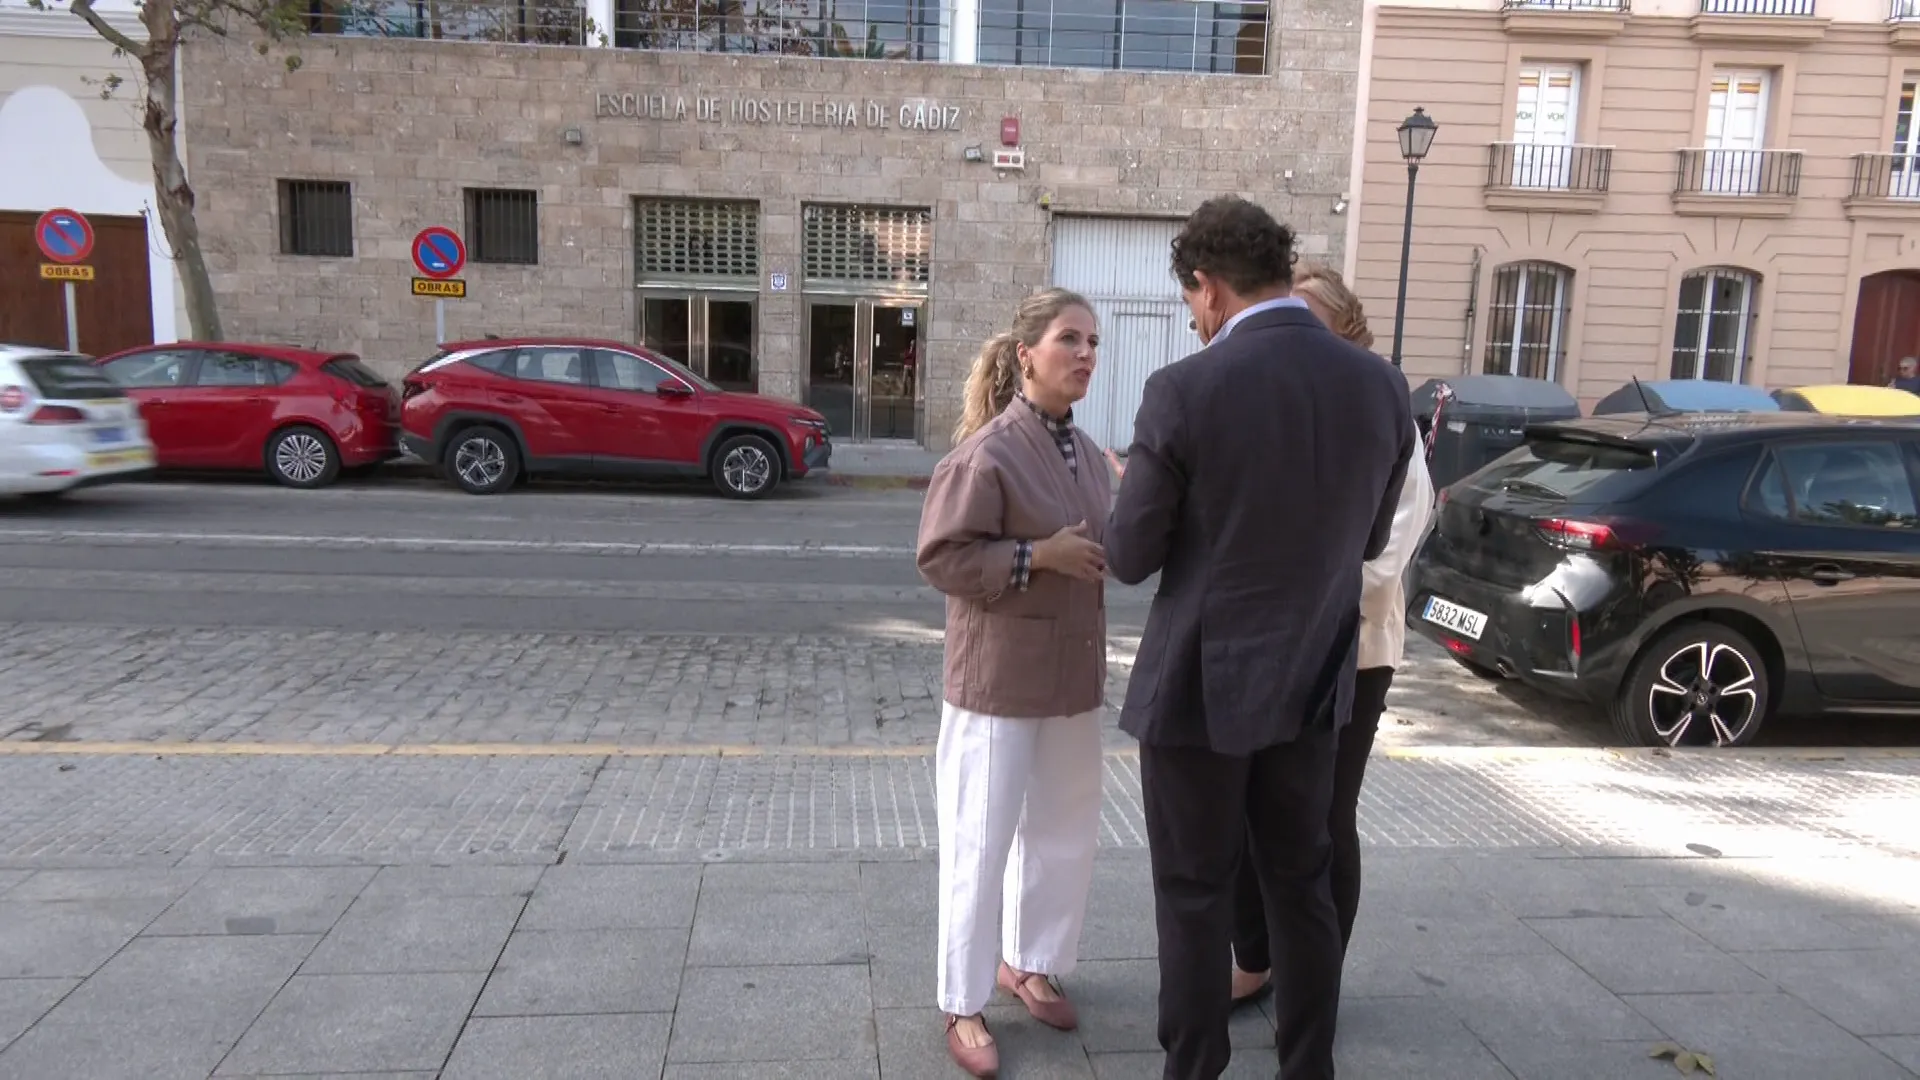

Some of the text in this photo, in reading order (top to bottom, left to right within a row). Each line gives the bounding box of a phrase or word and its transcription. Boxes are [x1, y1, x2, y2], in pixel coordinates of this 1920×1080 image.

[596, 92, 687, 120] ESCUELA
[696, 97, 720, 121] DE
[867, 103, 889, 129] DE
[45, 266, 89, 277] OBRAS
[417, 282, 460, 293] OBRAS
[1430, 601, 1479, 635] 5832 MSL
